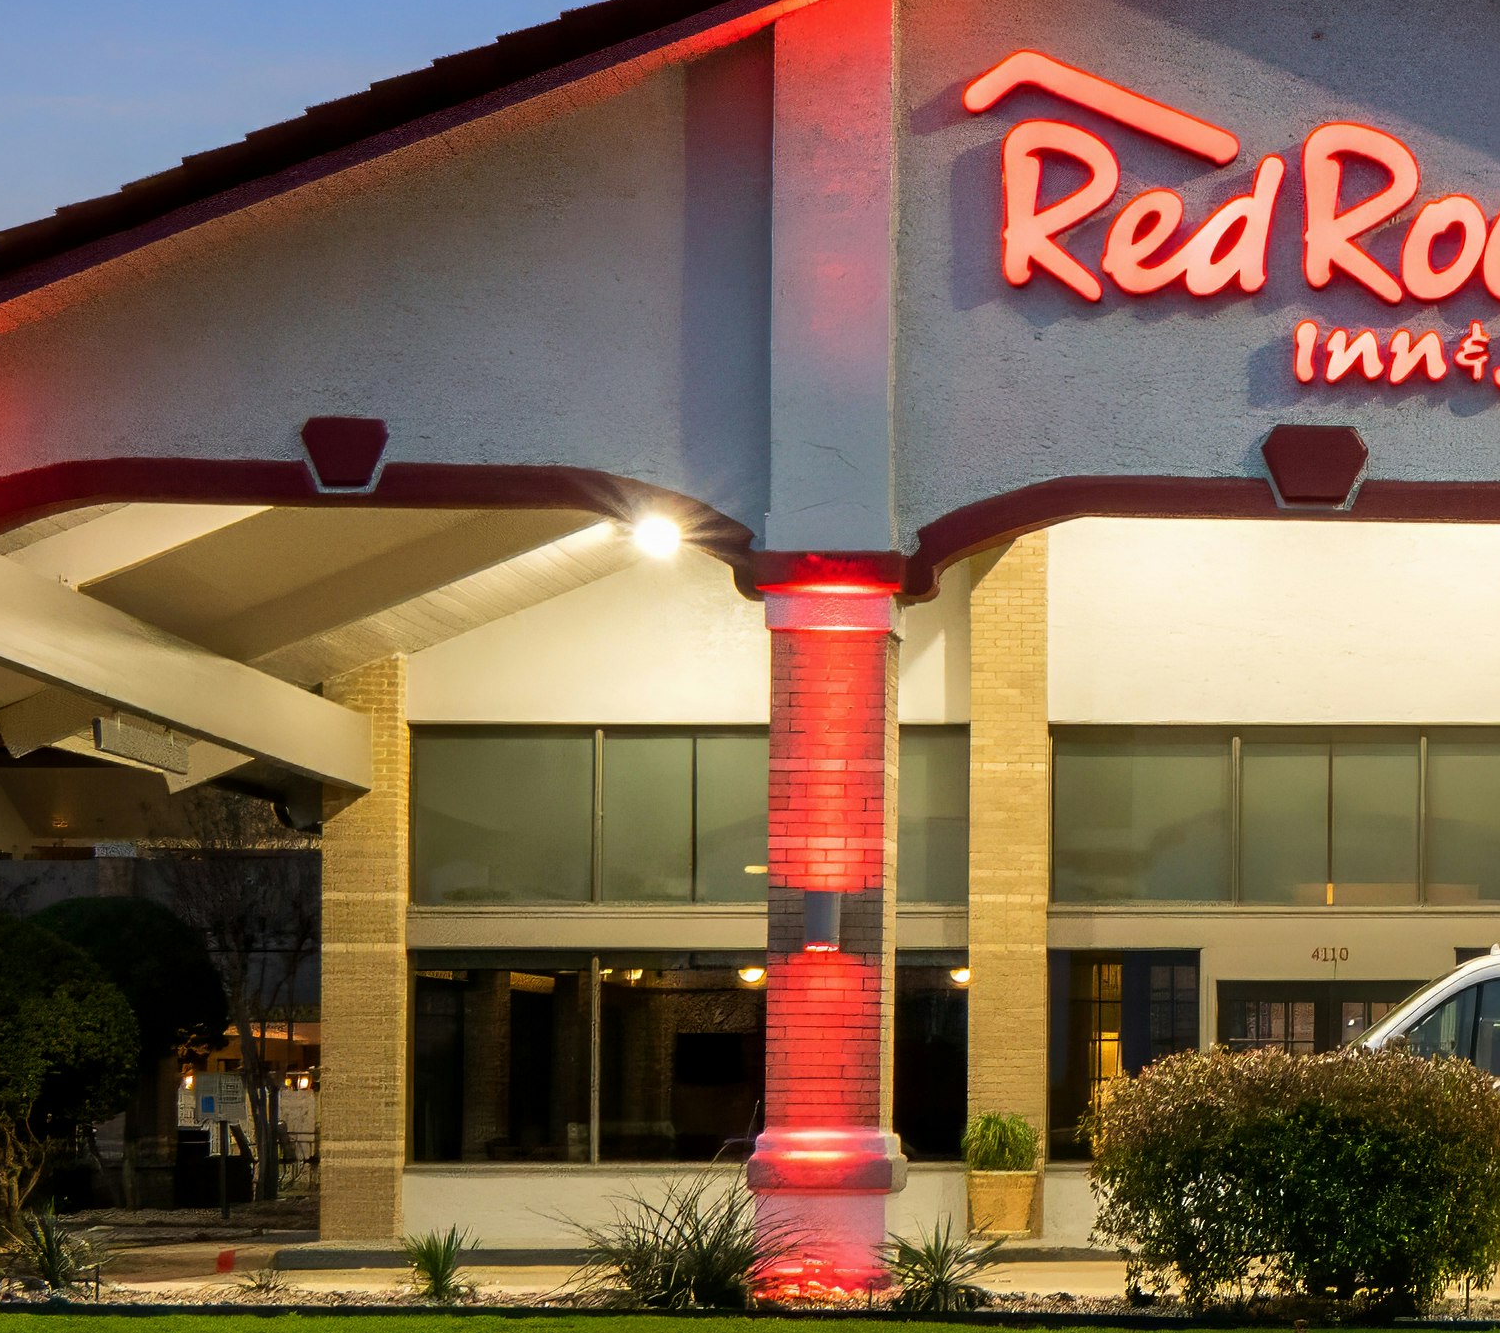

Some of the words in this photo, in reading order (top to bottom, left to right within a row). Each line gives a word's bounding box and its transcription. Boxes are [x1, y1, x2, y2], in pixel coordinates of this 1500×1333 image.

[1001, 119, 1286, 303] Red
[1293, 320, 1449, 385] Inn
[1311, 946, 1349, 962] 4110
